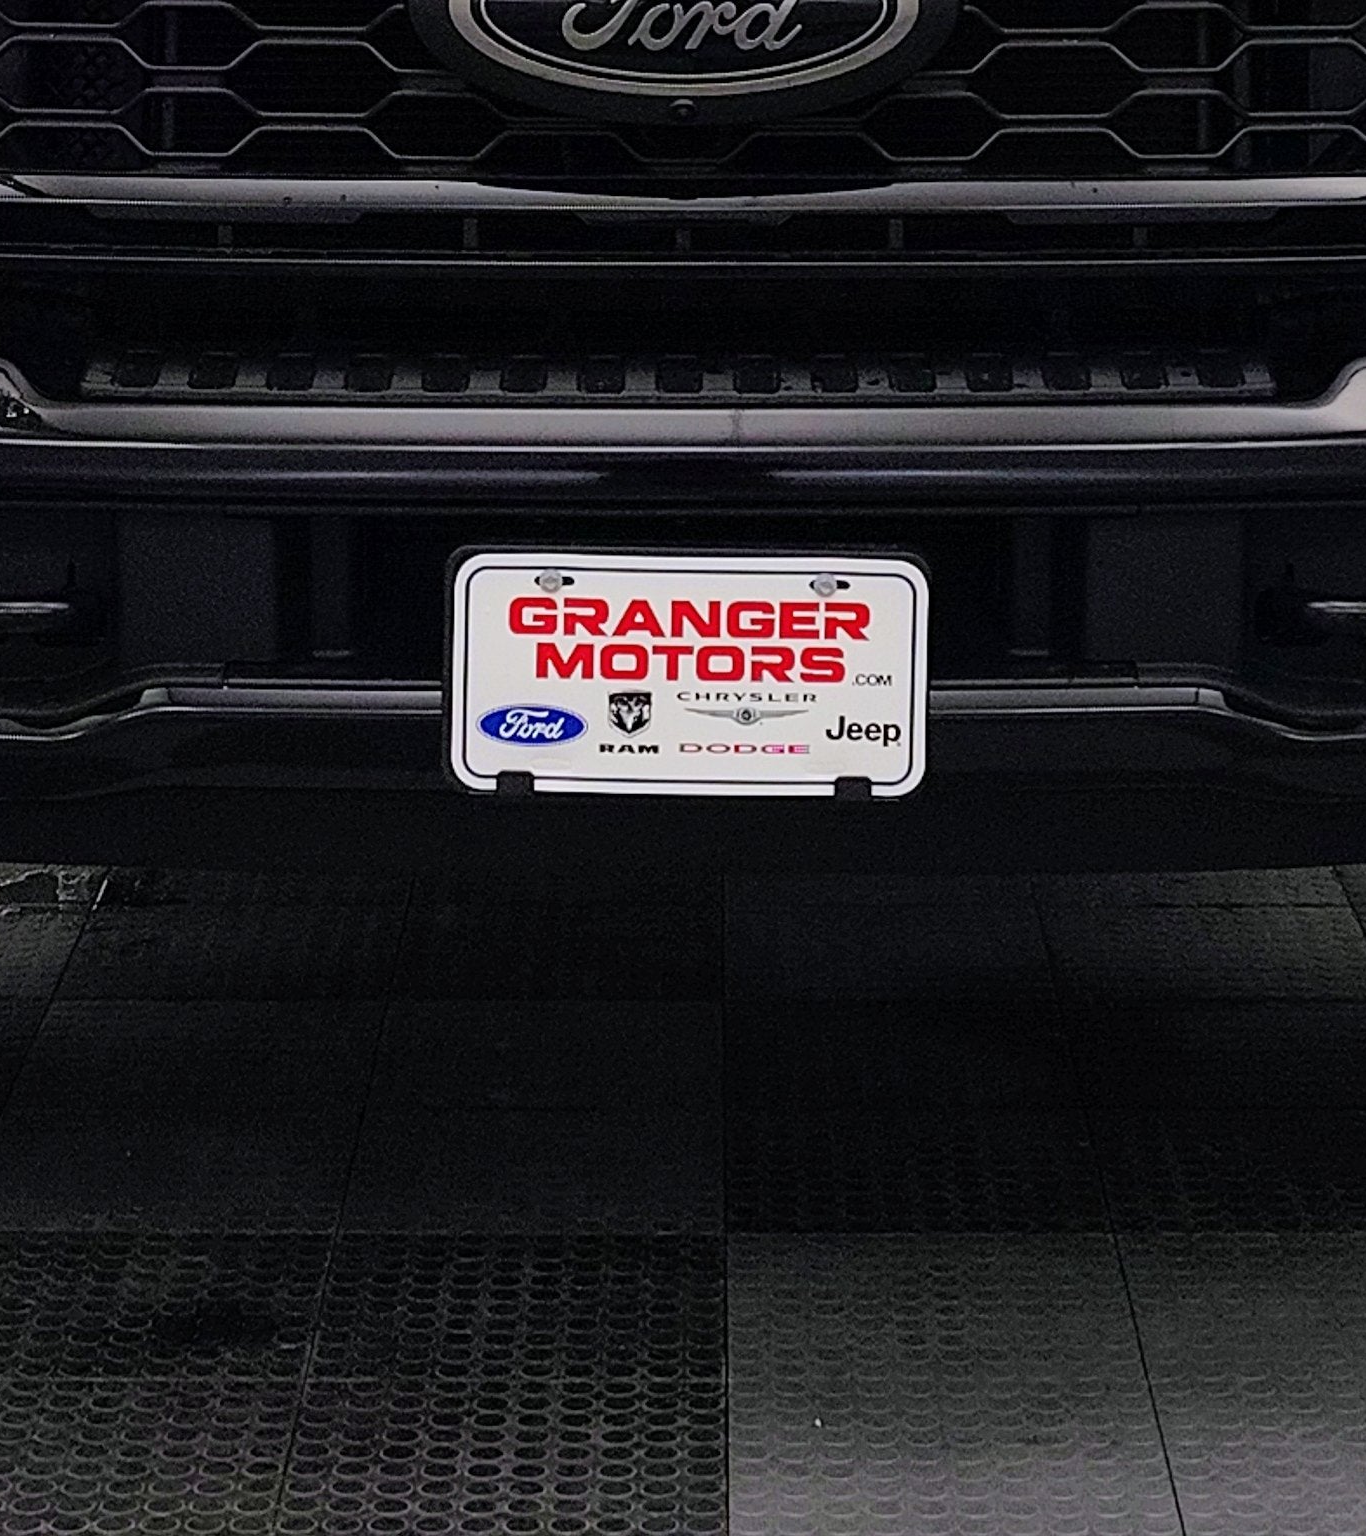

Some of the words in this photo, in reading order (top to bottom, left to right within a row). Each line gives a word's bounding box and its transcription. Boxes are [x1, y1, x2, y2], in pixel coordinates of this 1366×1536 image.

[508, 596, 871, 641] GRANGER
[535, 642, 846, 684] MOTORS
[851, 673, 893, 687] .COM
[676, 691, 818, 703] CHRYSLER
[498, 708, 566, 739] Ford
[825, 715, 902, 747] Jeep
[598, 743, 660, 754] RAM
[678, 742, 811, 755] DODGE
